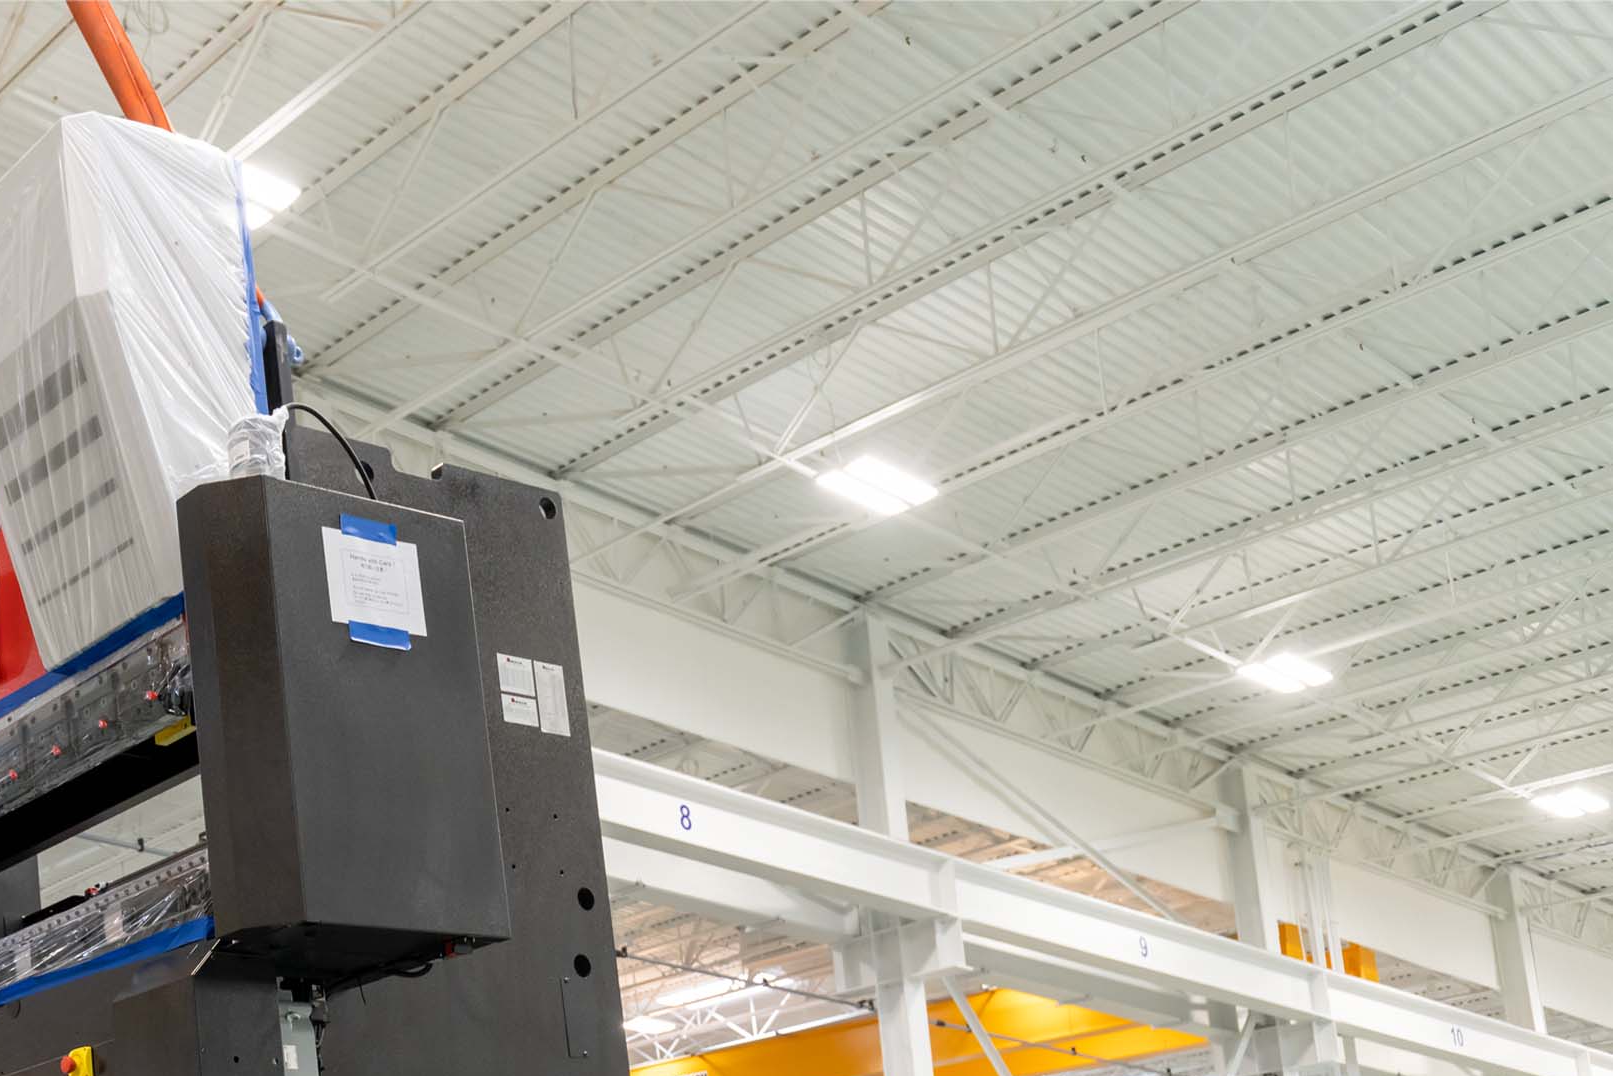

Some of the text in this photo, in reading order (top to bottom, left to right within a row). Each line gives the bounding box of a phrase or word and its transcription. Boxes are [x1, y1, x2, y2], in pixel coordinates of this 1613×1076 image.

[680, 804, 692, 831] 8
[1139, 936, 1148, 958] 9
[1451, 1028, 1464, 1048] 10
